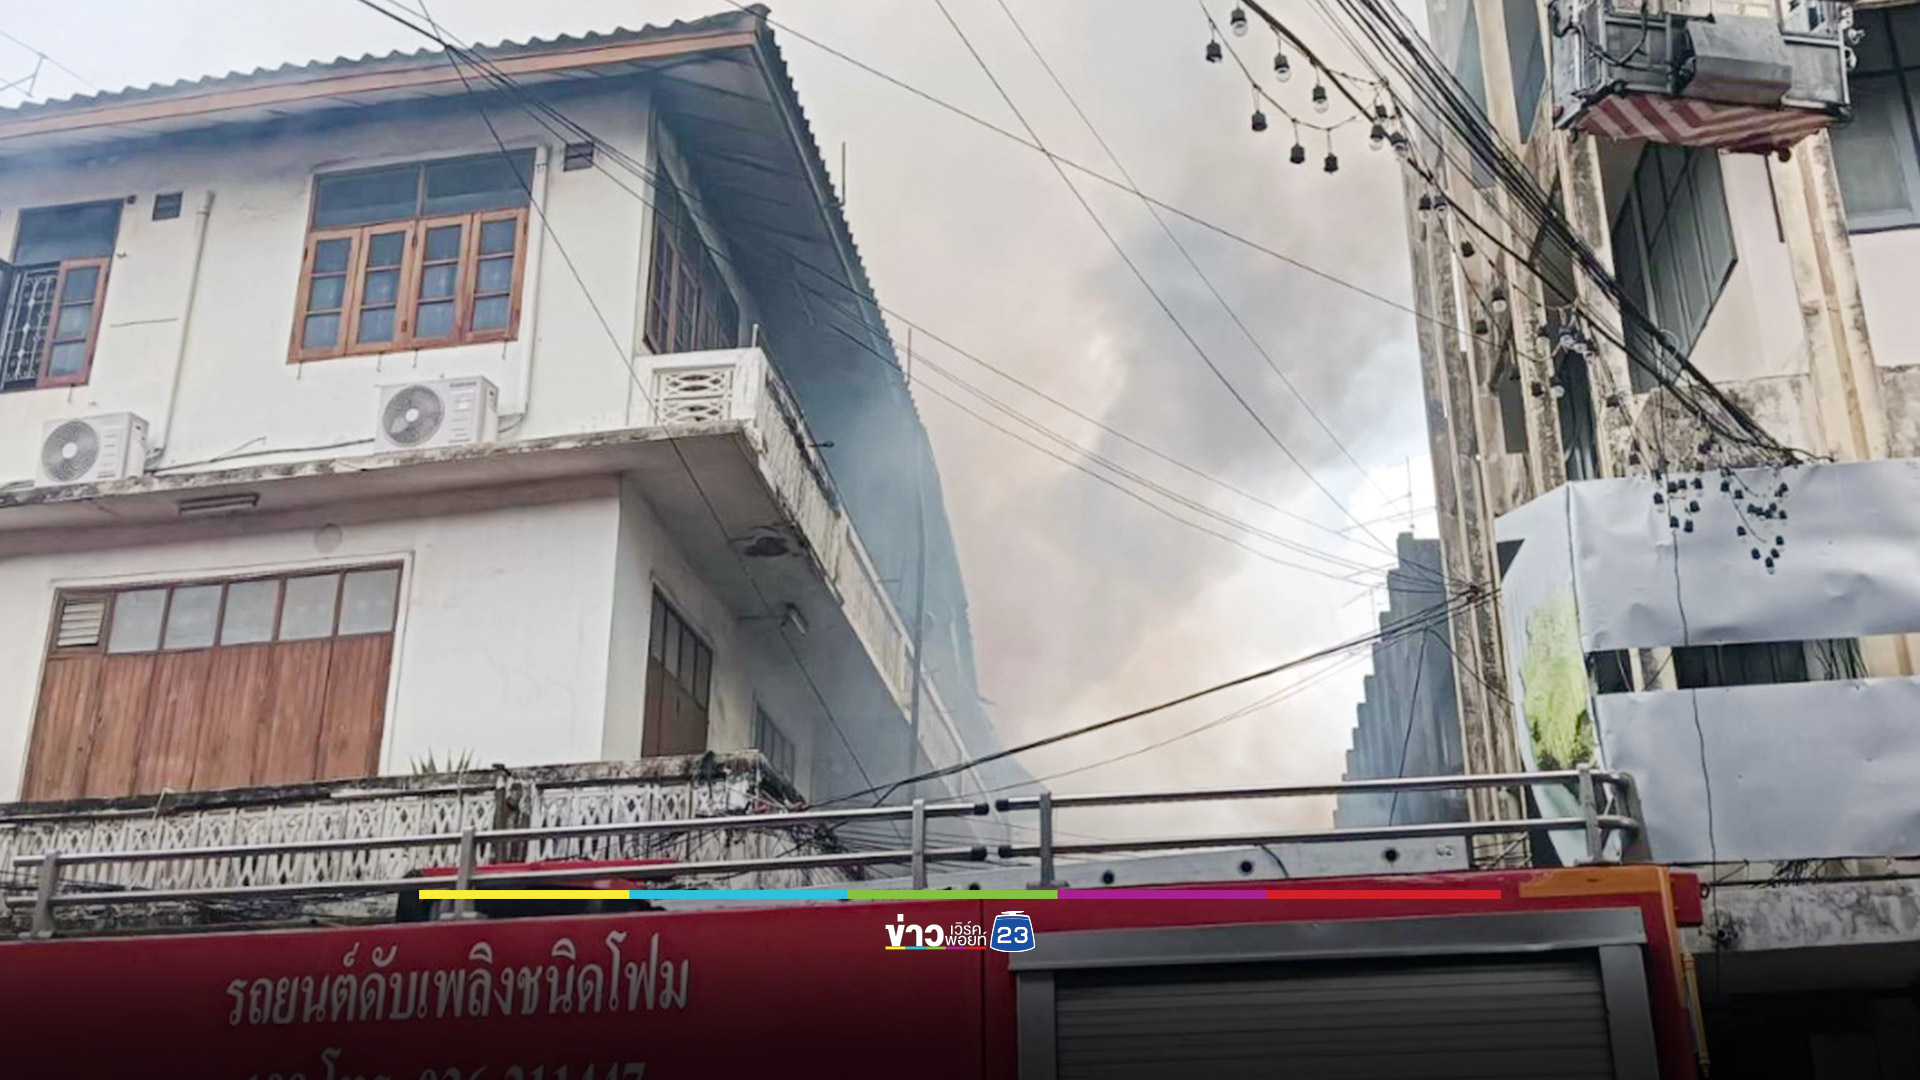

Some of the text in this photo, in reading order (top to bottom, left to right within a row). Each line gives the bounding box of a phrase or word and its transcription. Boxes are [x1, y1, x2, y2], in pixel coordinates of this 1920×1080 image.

[227, 930, 690, 1026] รถยนต์ดับเพลิงชนิดโฟม
